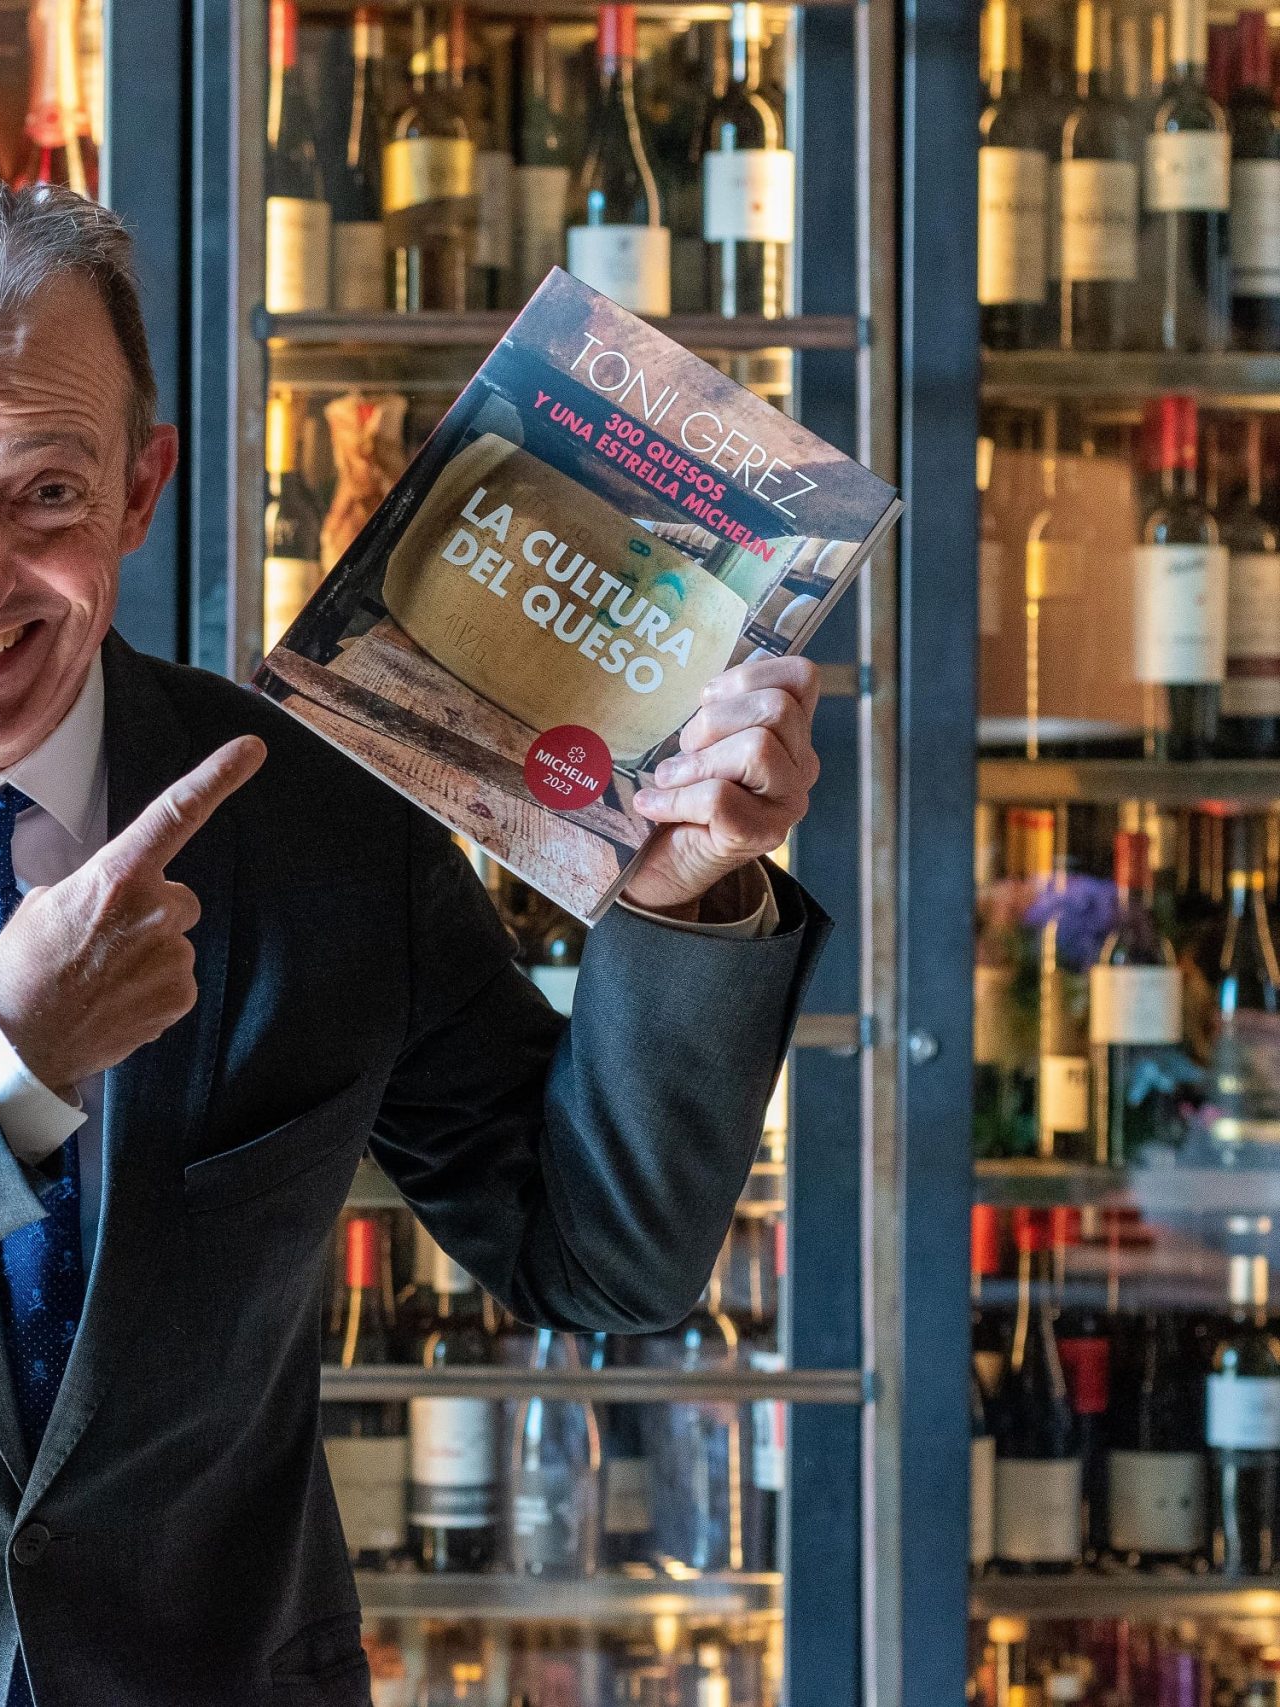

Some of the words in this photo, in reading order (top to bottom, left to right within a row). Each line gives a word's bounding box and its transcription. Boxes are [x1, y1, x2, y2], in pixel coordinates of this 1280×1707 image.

[533, 390, 552, 409] Y
[549, 402, 594, 443] UNA
[595, 434, 680, 500] ESTRELLA
[680, 493, 777, 563] MICHELIN
[570, 331, 680, 426] TONI
[680, 411, 819, 519] GEREZ
[604, 413, 646, 447] 300
[646, 441, 727, 502] QUESOS
[441, 528, 515, 598] DEL
[522, 585, 664, 694] QUESO
[460, 486, 514, 544] LA
[522, 530, 695, 669] CULTURA
[535, 749, 600, 791] MICHELIN
[542, 773, 573, 795] 2023
